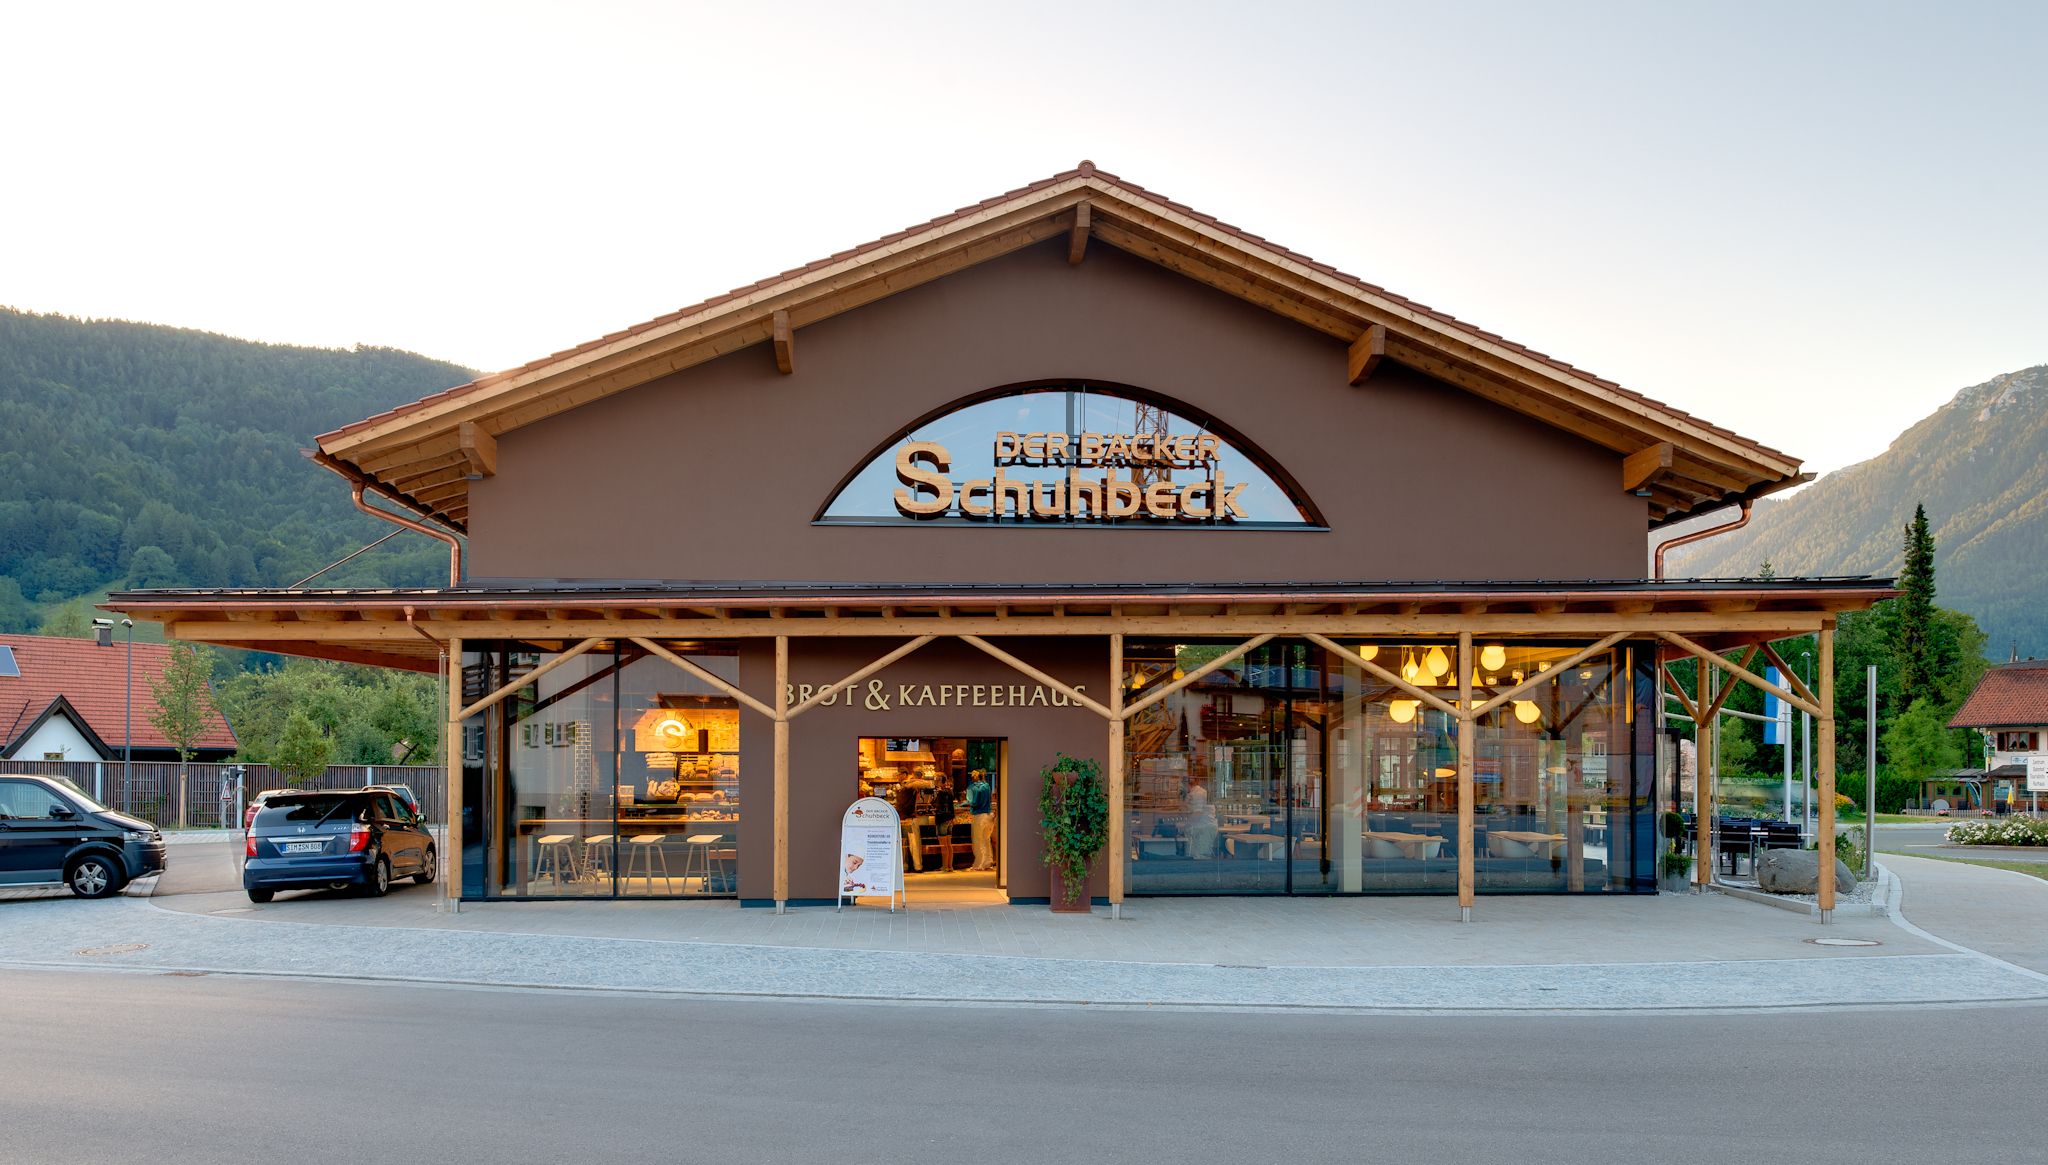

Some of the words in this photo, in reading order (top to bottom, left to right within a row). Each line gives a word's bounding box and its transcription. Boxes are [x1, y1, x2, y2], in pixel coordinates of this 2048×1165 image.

[996, 431, 1069, 459] DER
[1081, 432, 1221, 461] BÄCKER
[893, 441, 1249, 518] Schuhbeck
[787, 683, 858, 706] BROT
[864, 679, 891, 711] &
[899, 683, 1086, 707] KAFFEEHAUS
